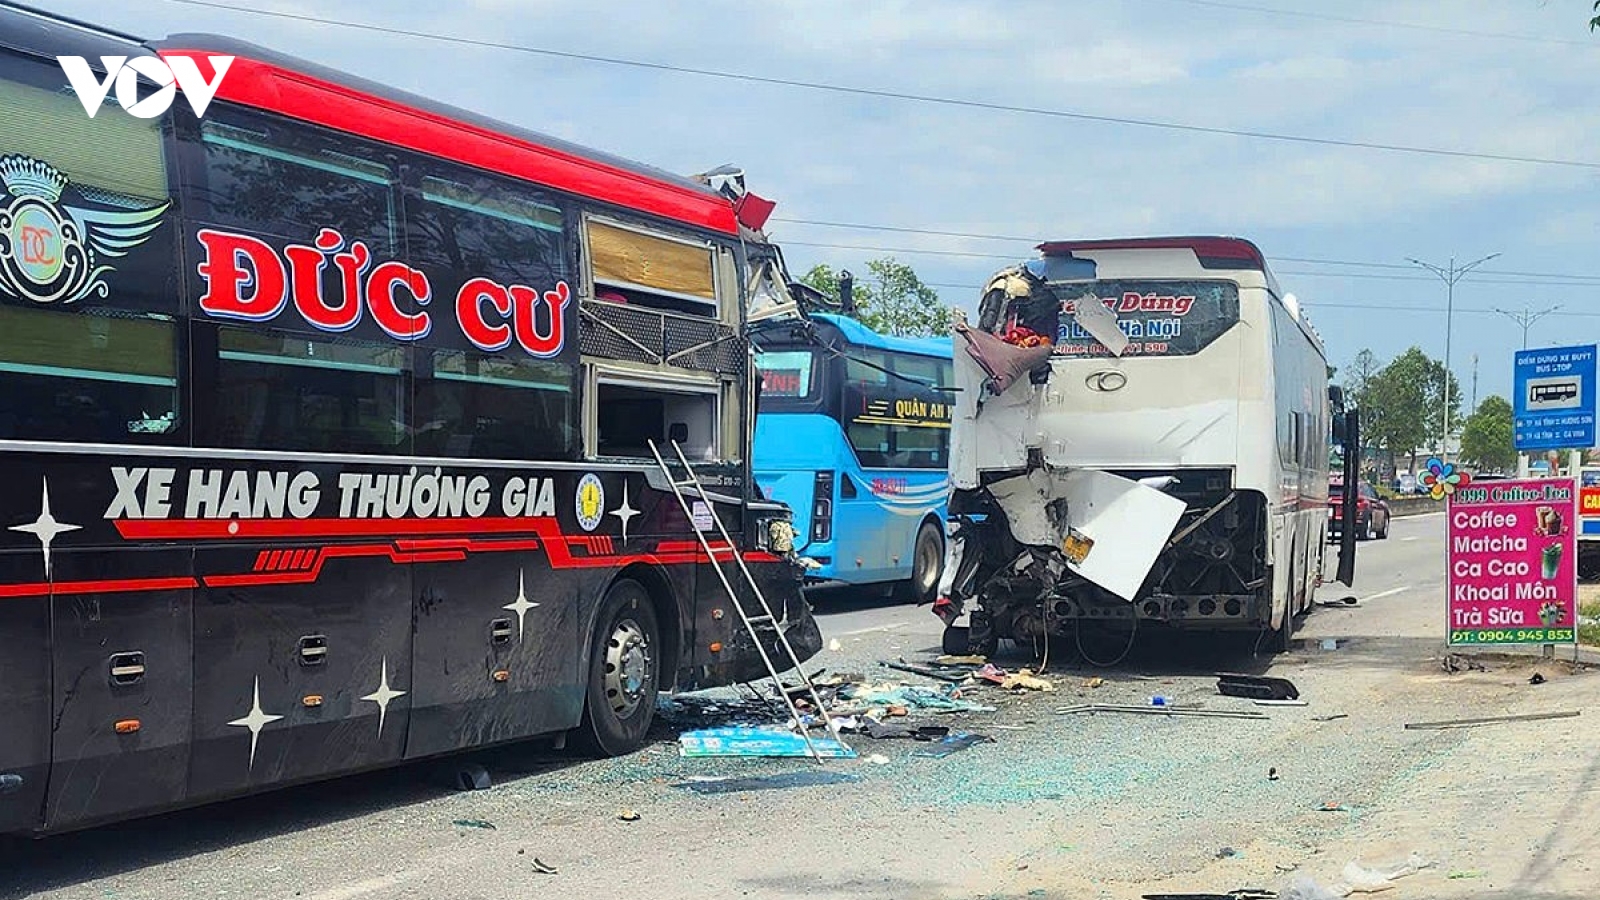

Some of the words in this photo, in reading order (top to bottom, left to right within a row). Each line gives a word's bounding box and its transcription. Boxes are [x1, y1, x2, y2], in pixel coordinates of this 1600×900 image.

[197, 227, 432, 341] ĐỨC
[455, 277, 571, 358] CƯ
[1147, 318, 1181, 340] Nội
[103, 467, 177, 519] XE
[338, 466, 491, 519] THƯƠNG
[502, 476, 556, 517] GIA
[1453, 511, 1517, 528] Coffee
[1454, 535, 1528, 553] Matcha
[1454, 561, 1482, 577] Ca
[1487, 559, 1529, 576] Cao
[1454, 583, 1509, 601] Khoai
[1515, 582, 1557, 600] Môn
[1454, 607, 1482, 626] Trà
[1488, 607, 1524, 625] Sữa
[1478, 630, 1514, 641] 0904
[1517, 630, 1544, 641] 945
[1547, 629, 1573, 640] 853
